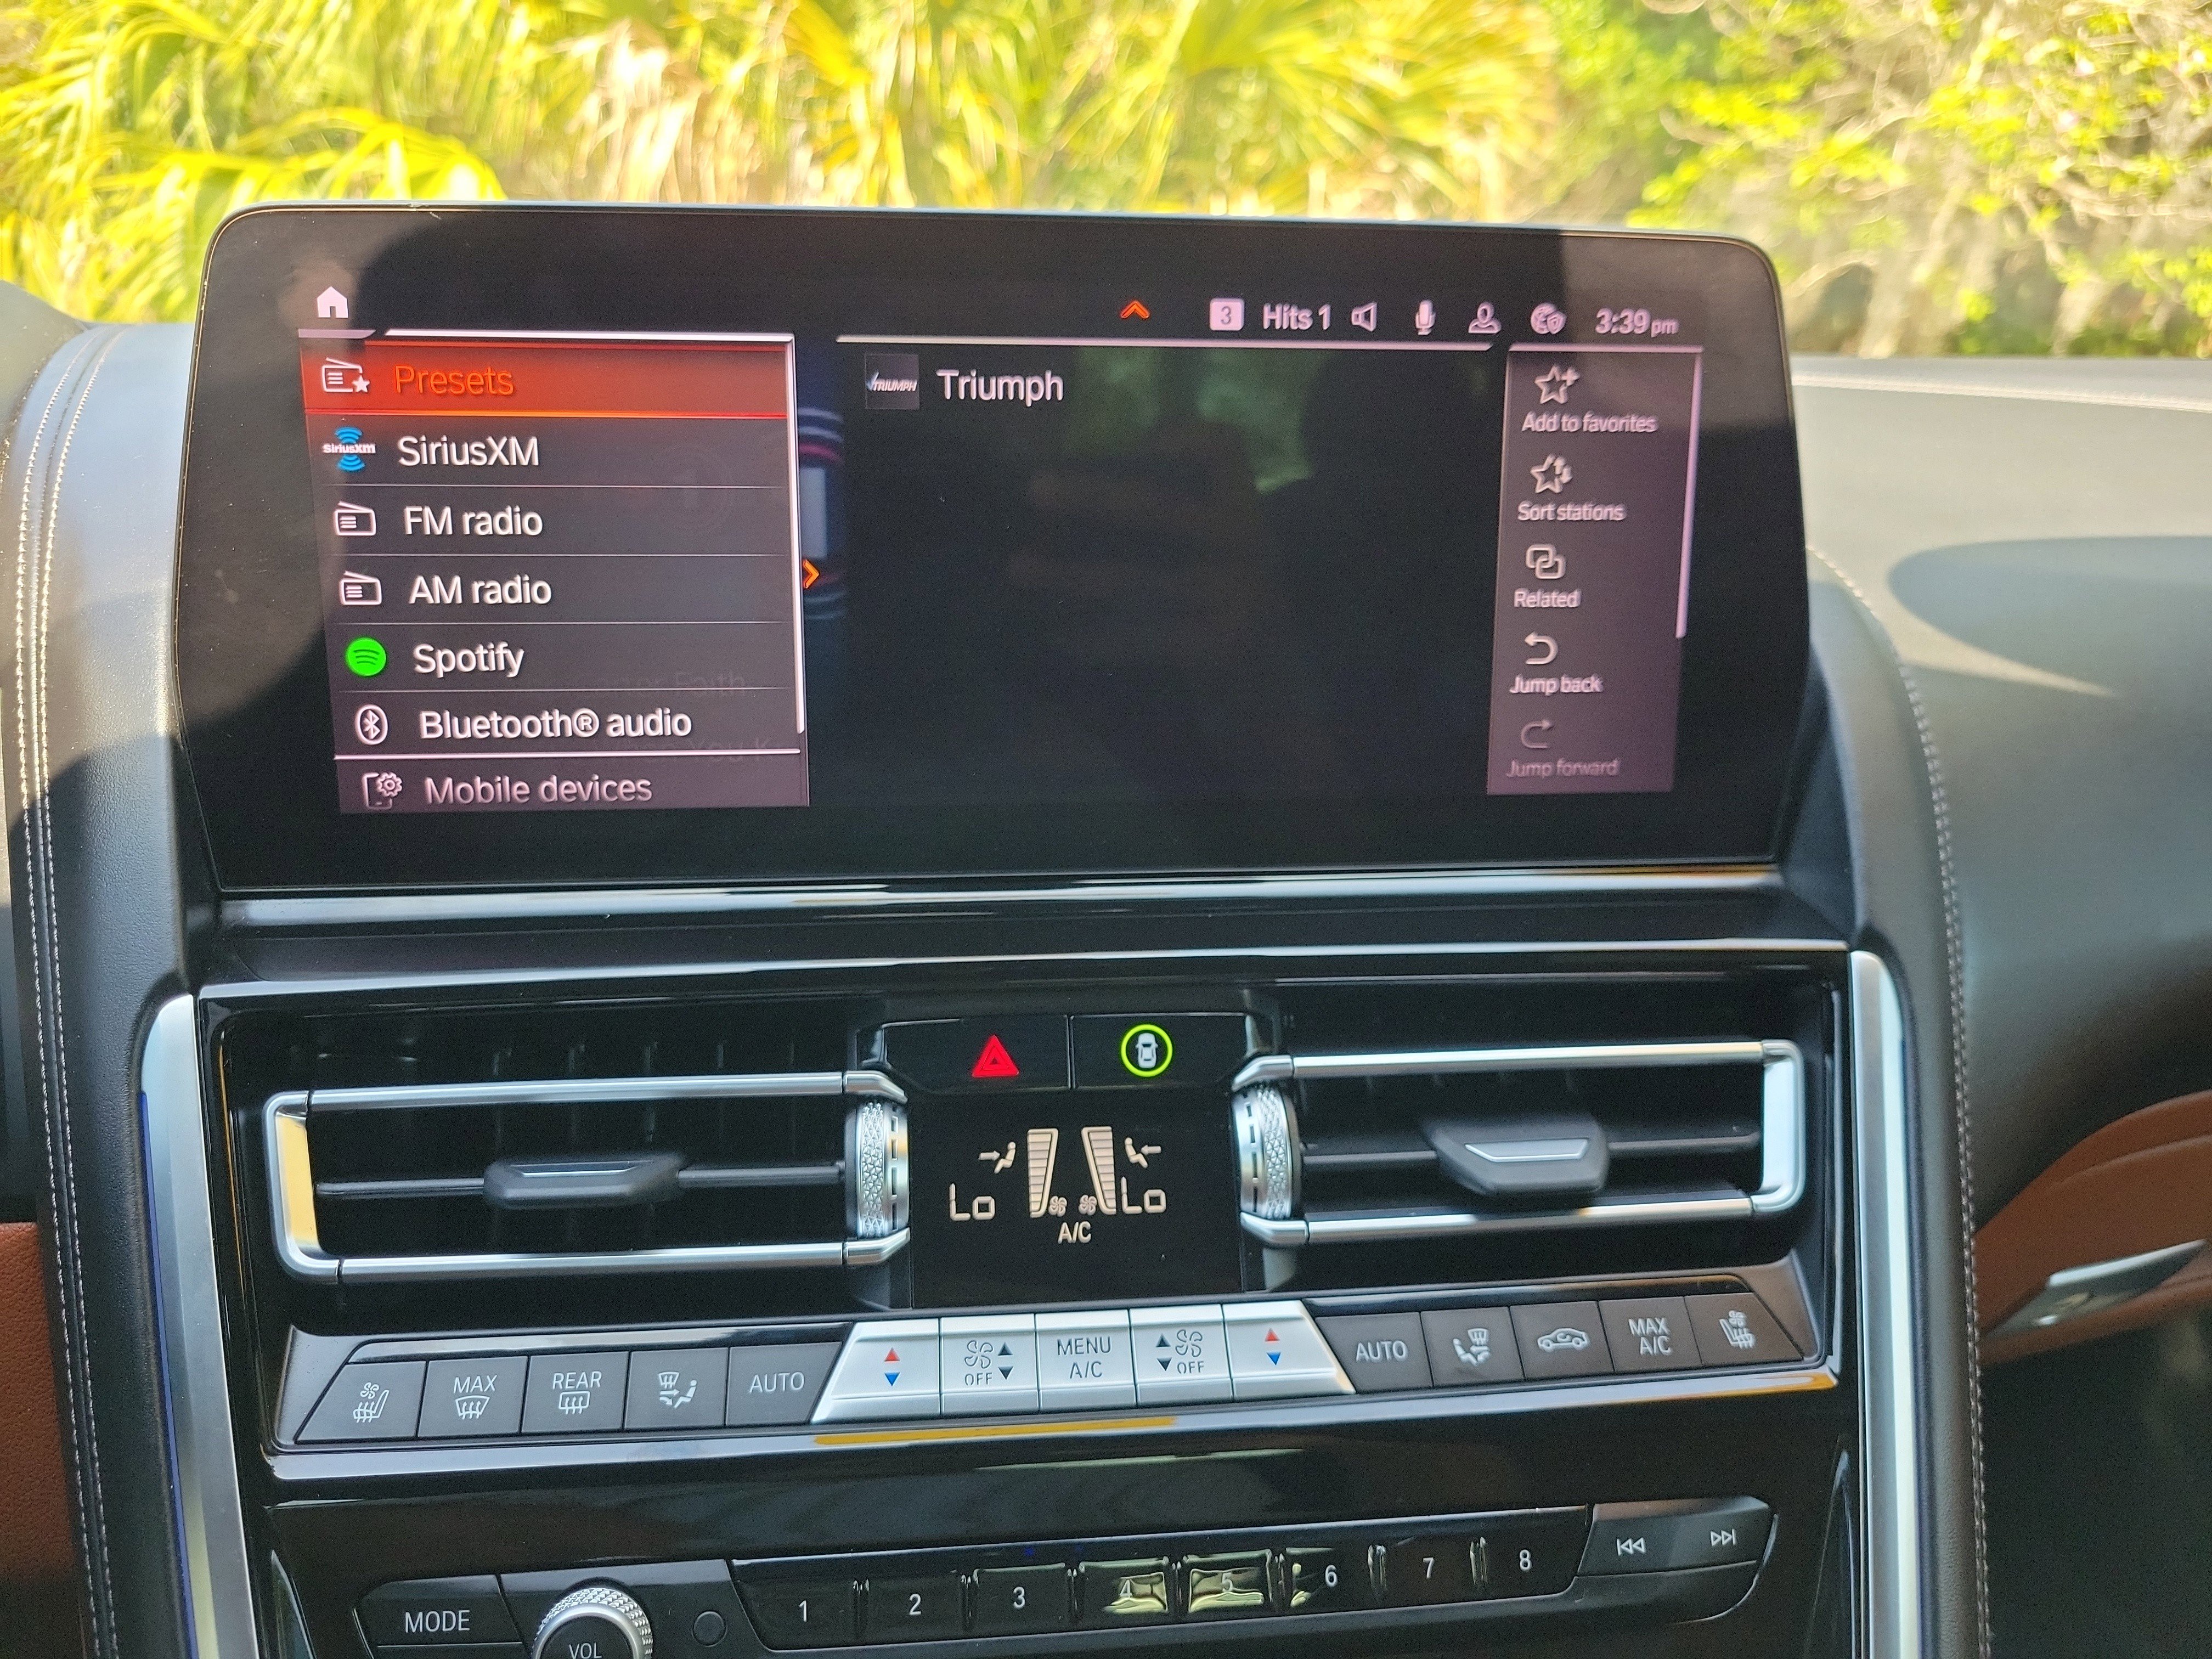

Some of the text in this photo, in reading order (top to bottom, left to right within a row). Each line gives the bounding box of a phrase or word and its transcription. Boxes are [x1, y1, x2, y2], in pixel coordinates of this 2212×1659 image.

[1220, 305, 1232, 325] 3
[1263, 303, 1331, 330] Hits 1
[1595, 308, 1679, 337] 3:39 pm
[394, 365, 514, 396] Presets
[935, 369, 1064, 407] Triumph
[1521, 411, 1658, 433] Add to favorites
[398, 436, 540, 467] SiriusXM
[404, 506, 543, 536] FM radio
[1517, 500, 1627, 522] Sort stations
[408, 575, 552, 605] AM radio
[1514, 589, 1581, 608] Related
[413, 642, 524, 678] Spotify
[1509, 675, 1603, 695] Jump back
[419, 708, 692, 740] Bluetooth® audio
[1506, 759, 1619, 778] Jump forward
[426, 775, 653, 804] Mobile devices
[949, 1183, 995, 1221] Lo
[1121, 1176, 1167, 1215] Lo
[1058, 1221, 1092, 1244] A/C
[1628, 1318, 1669, 1337] MAX
[1057, 1336, 1112, 1357] MENU
[1356, 1340, 1408, 1362] AUTO
[1639, 1337, 1672, 1356] A/C
[1070, 1362, 1103, 1380] A/C
[1177, 1361, 1205, 1375] OFF
[453, 1375, 497, 1394] MAX
[552, 1372, 602, 1390] REAR
[749, 1372, 805, 1393] AUTO
[964, 1373, 992, 1386] OFF
[1423, 1557, 1435, 1579] 7
[1519, 1550, 1532, 1571] 8
[1325, 1564, 1338, 1587] 6
[909, 1594, 922, 1616] 2
[1013, 1587, 1026, 1609] 3
[404, 1610, 471, 1633] MODE
[799, 1600, 808, 1622] 1
[568, 1642, 602, 1659] VOL
